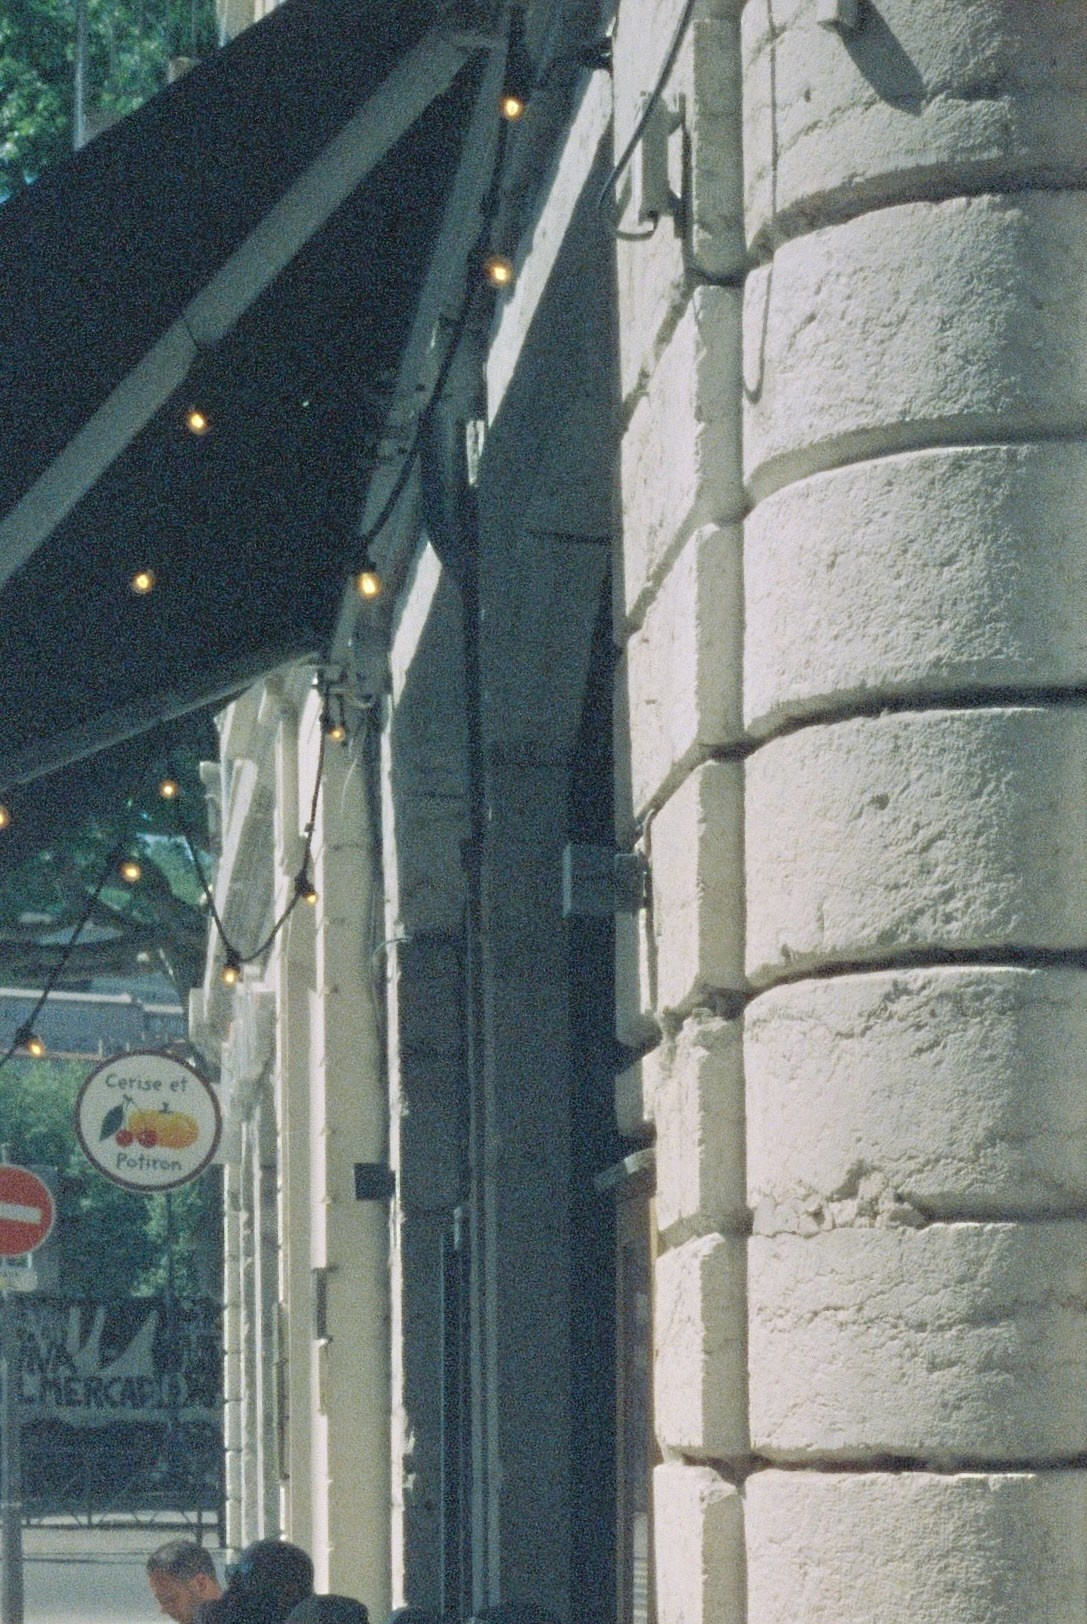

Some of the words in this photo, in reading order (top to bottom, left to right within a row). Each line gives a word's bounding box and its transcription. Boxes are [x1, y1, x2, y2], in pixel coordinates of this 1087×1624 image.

[104, 1072, 162, 1091] Cerise
[169, 1076, 188, 1093] et
[115, 1151, 182, 1171] Potiron
